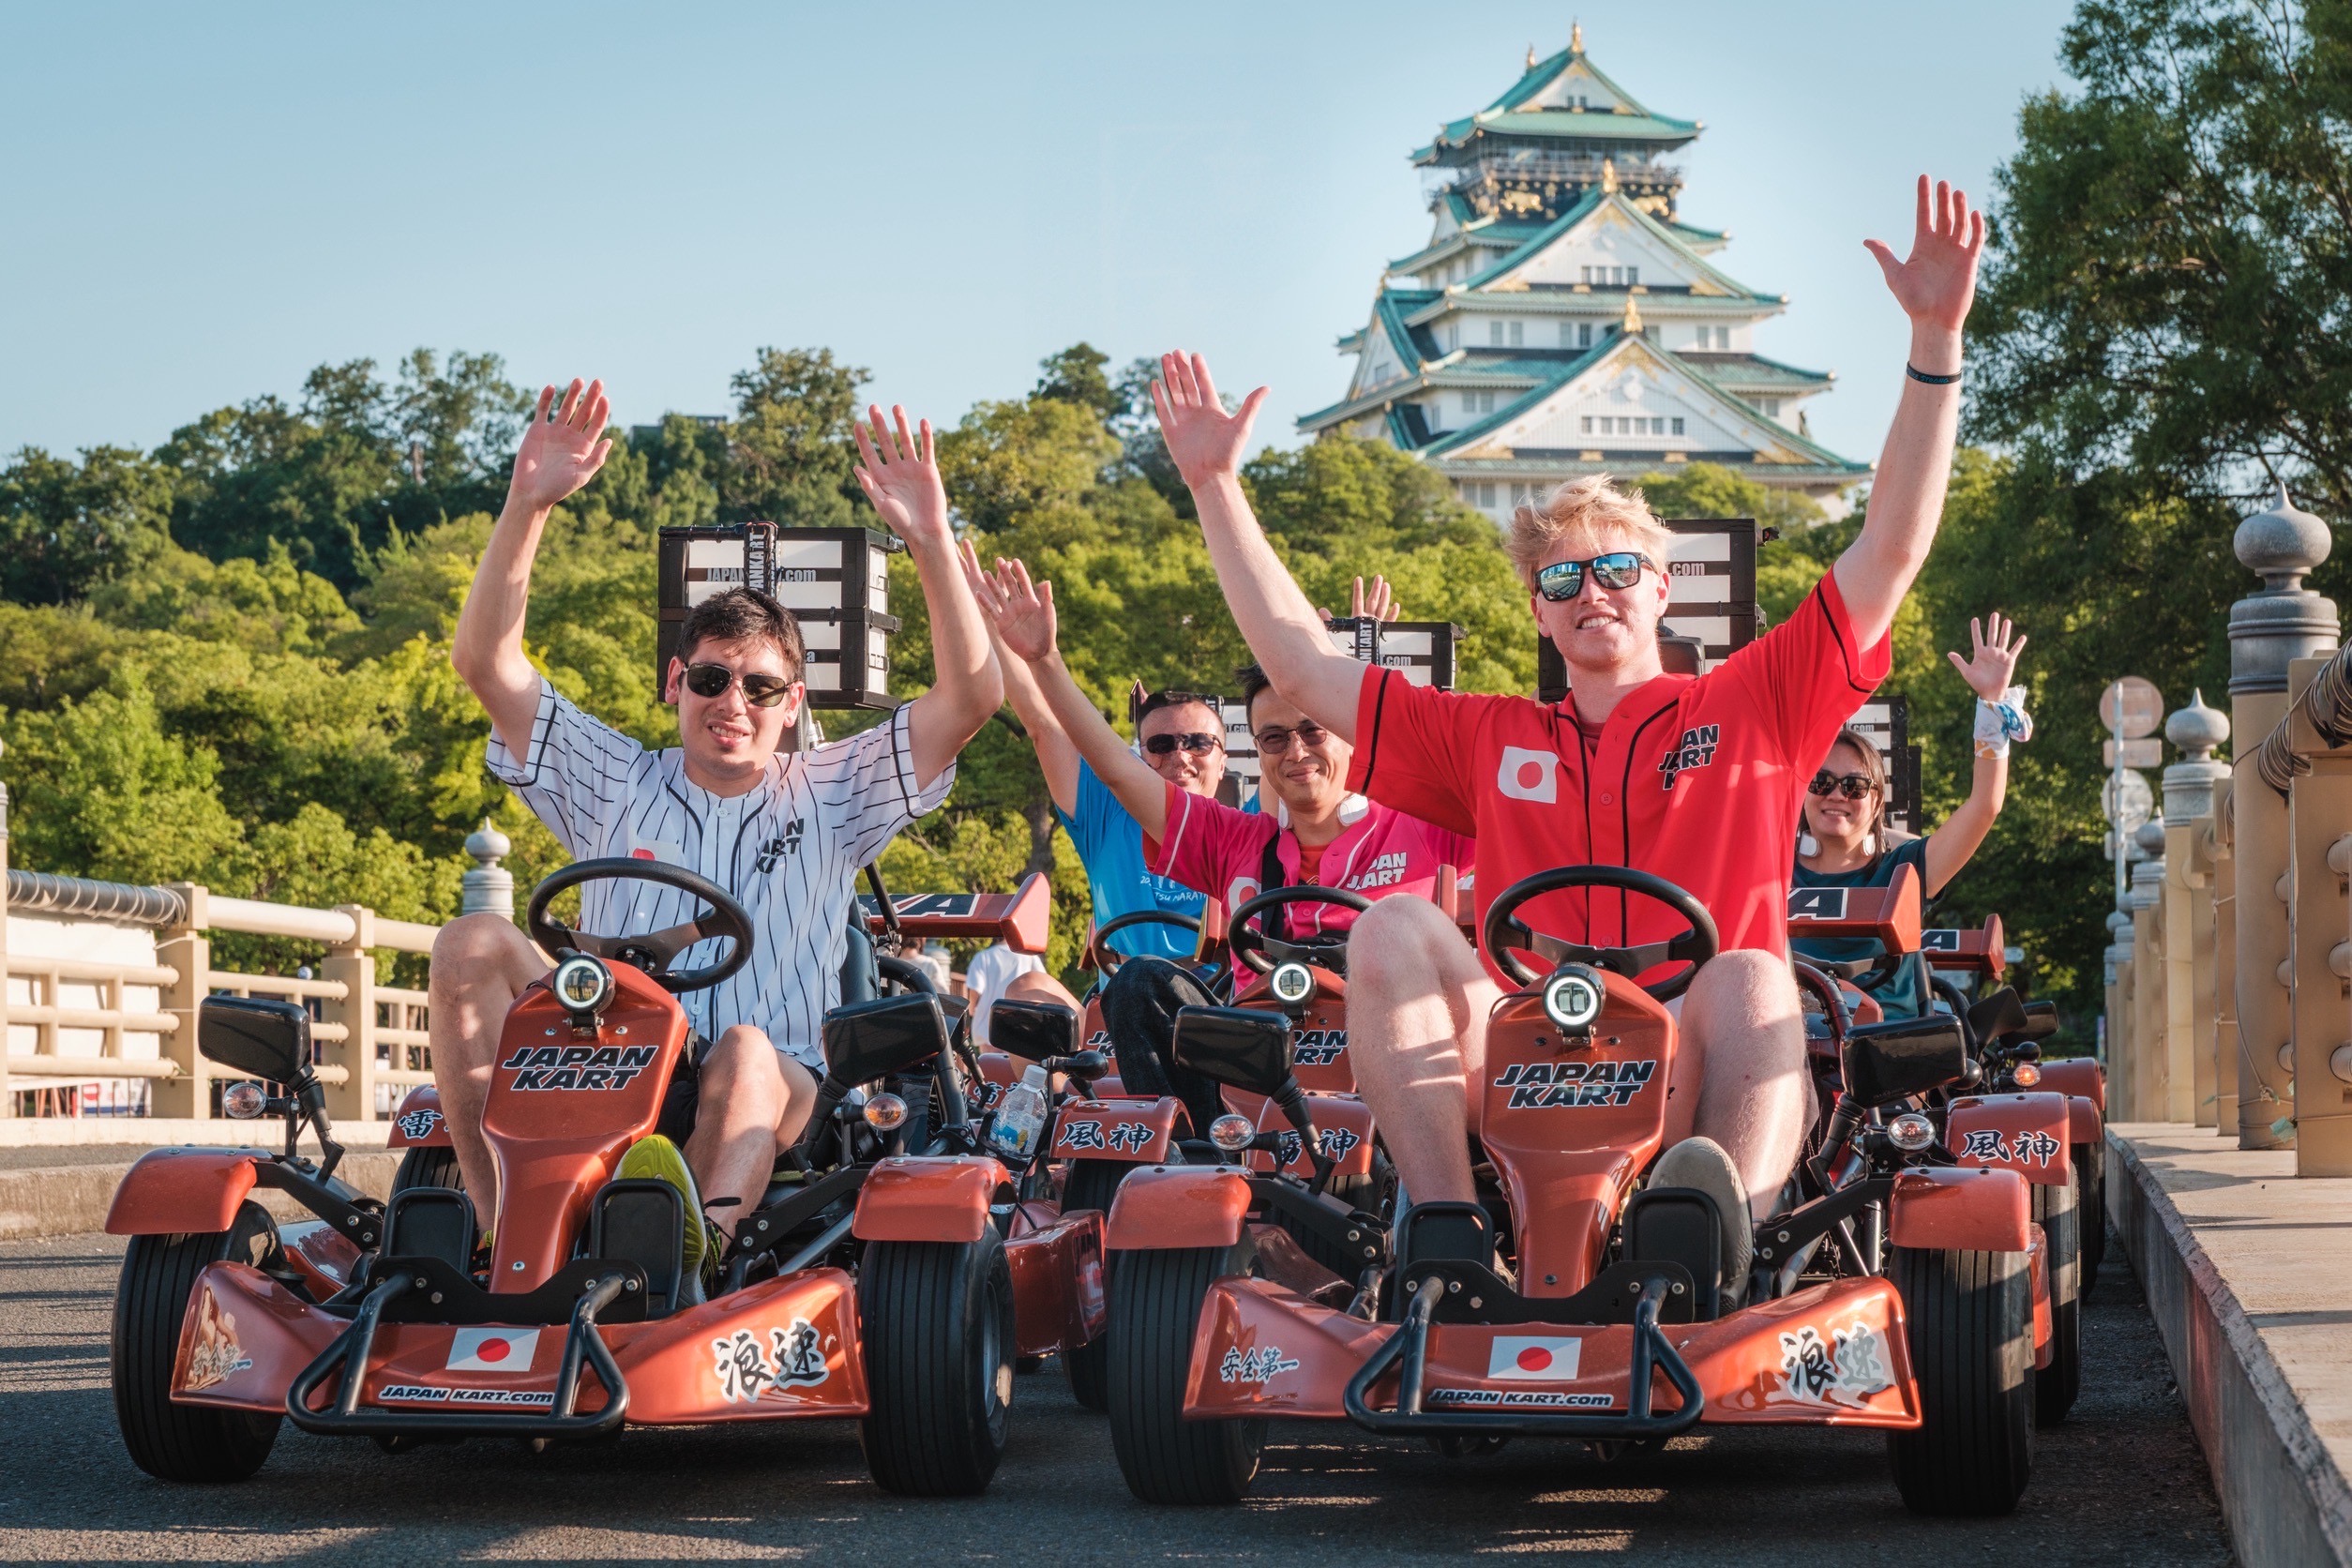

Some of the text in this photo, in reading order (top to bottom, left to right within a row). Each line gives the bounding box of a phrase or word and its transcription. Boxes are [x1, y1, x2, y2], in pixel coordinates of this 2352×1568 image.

[502, 1045, 659, 1070] JAPAN
[510, 1067, 642, 1091] KART
[1494, 1060, 1657, 1087] JAPAN
[1508, 1084, 1643, 1109] KART
[398, 1108, 449, 1139] 雷
[1057, 1120, 1155, 1154] 風神
[1961, 1130, 2060, 1168] 風神
[1221, 1347, 1299, 1383] 安全第一
[381, 1386, 554, 1404] JAPAN KART.com
[1429, 1390, 1613, 1407] JAPAN KART.com
